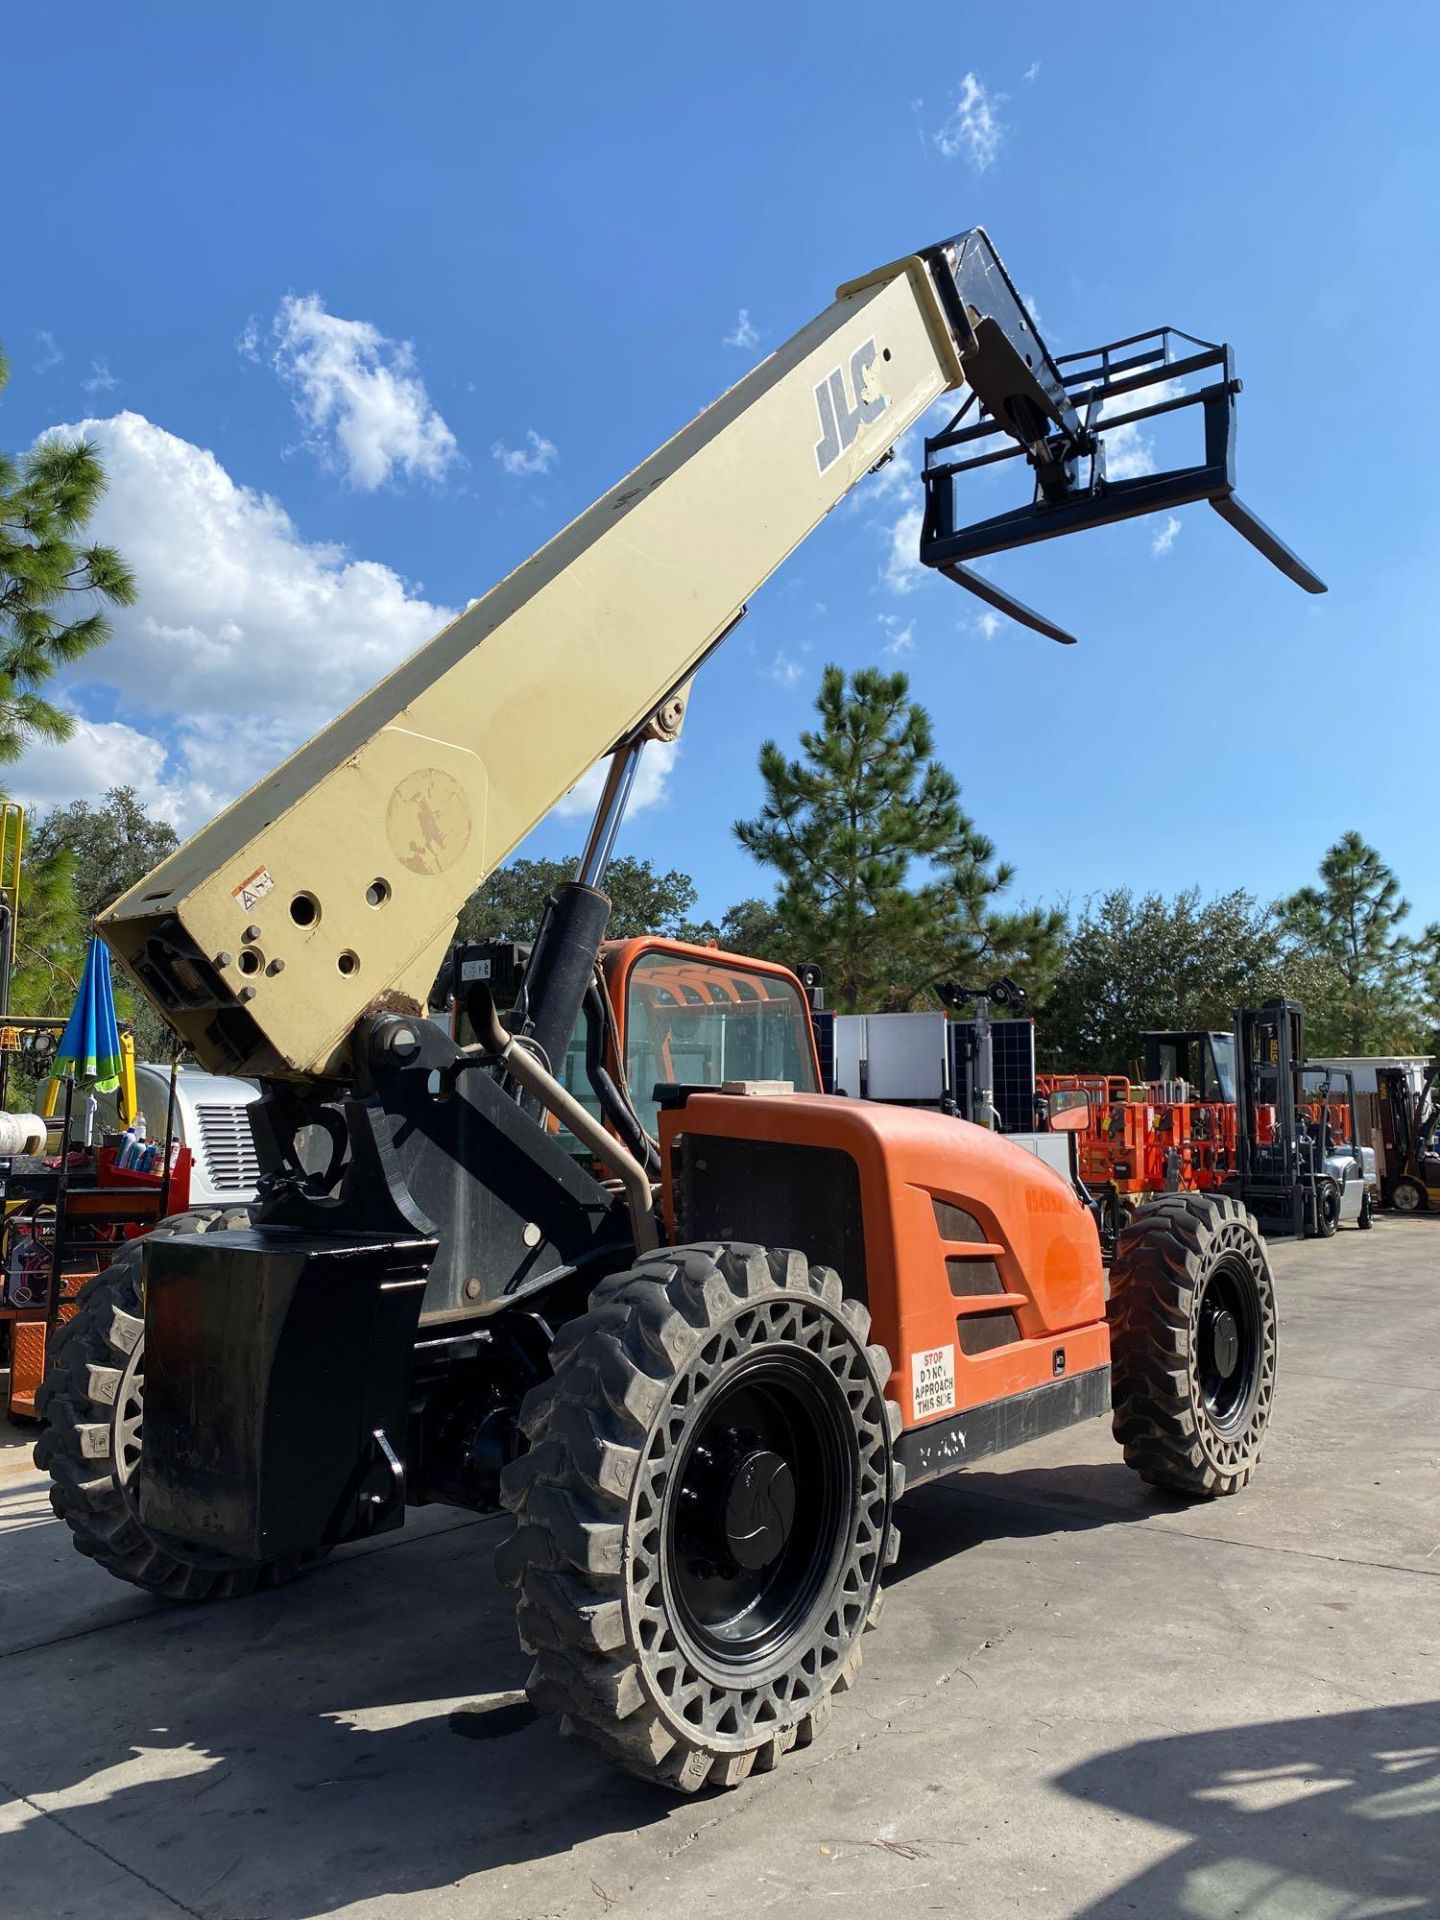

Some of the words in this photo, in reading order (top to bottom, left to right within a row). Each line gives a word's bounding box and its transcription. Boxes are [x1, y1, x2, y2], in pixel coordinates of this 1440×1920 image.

[814, 335, 889, 476] JLG
[924, 1351, 943, 1367] STOP
[915, 1377, 953, 1400] APPROACH
[917, 1397, 934, 1414] THIS
